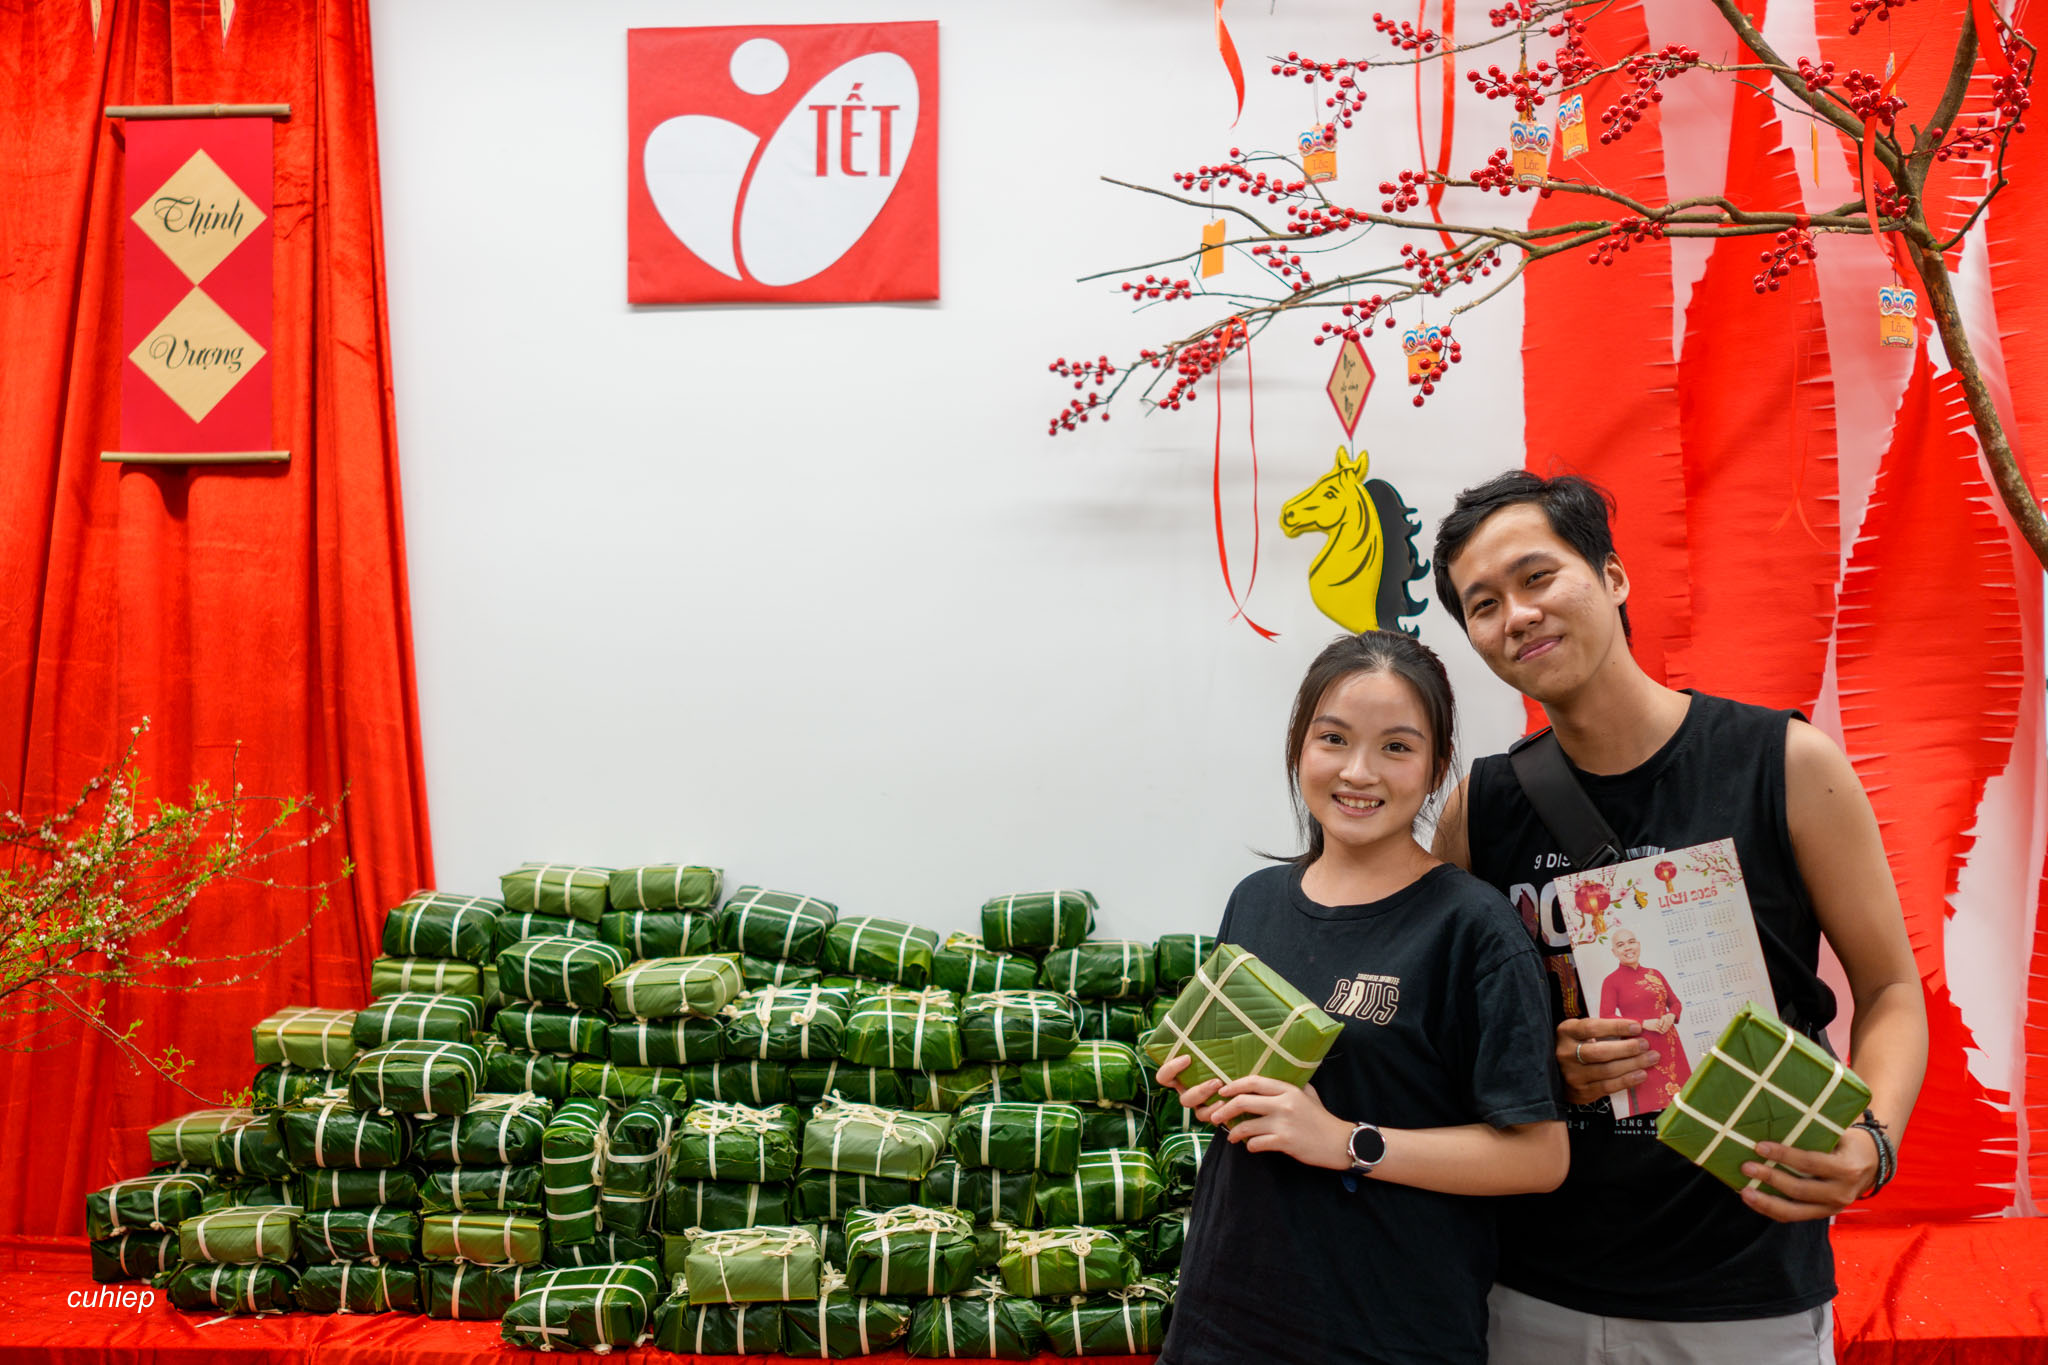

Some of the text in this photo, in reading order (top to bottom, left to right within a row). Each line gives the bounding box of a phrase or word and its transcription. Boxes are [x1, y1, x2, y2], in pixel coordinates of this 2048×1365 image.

[808, 82, 901, 177] TẾT
[153, 195, 244, 238] Thịnh
[149, 333, 245, 374] Vượng
[1690, 886, 1718, 901] 2026
[1615, 1119, 1643, 1127] LONG
